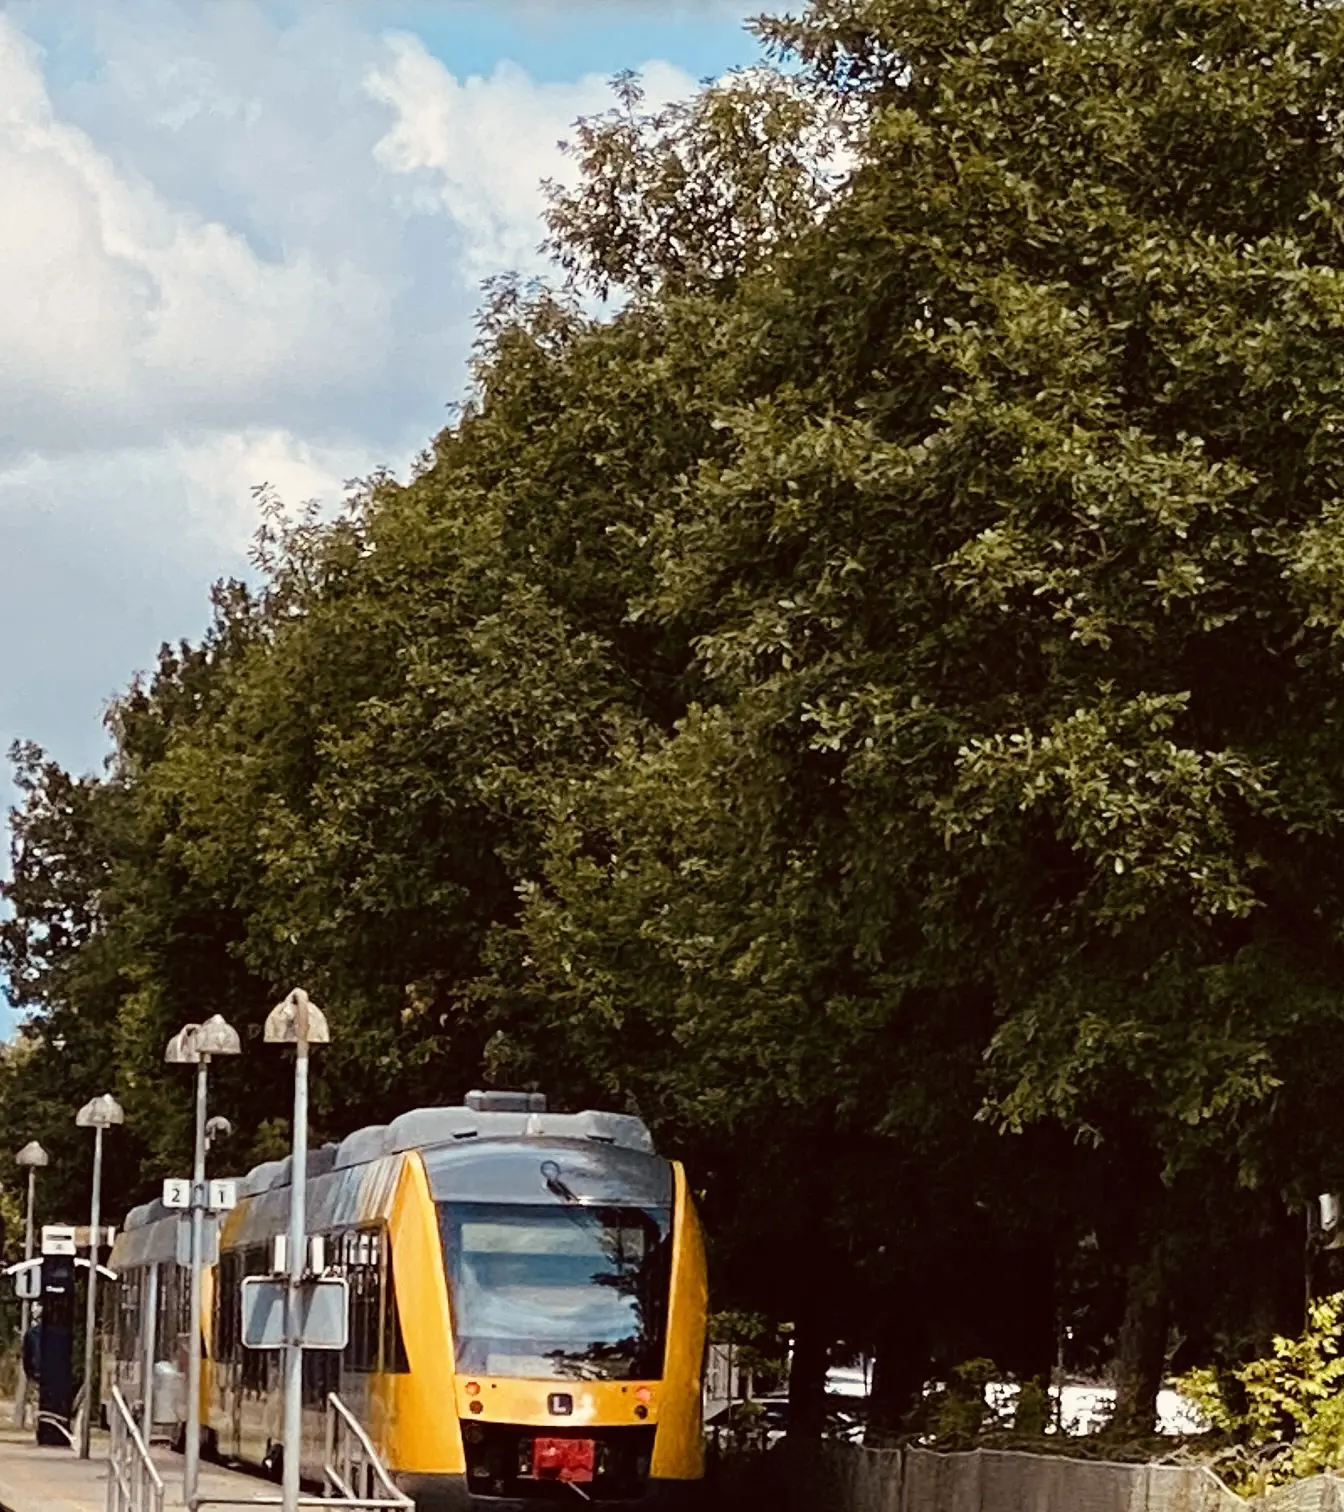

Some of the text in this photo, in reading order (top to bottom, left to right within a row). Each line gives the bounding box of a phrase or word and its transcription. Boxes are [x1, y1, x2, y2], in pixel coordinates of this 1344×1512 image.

[172, 1188, 180, 1202] 2
[219, 1190, 224, 1203] 1
[23, 1269, 32, 1294] 1
[553, 1396, 566, 1412] L
